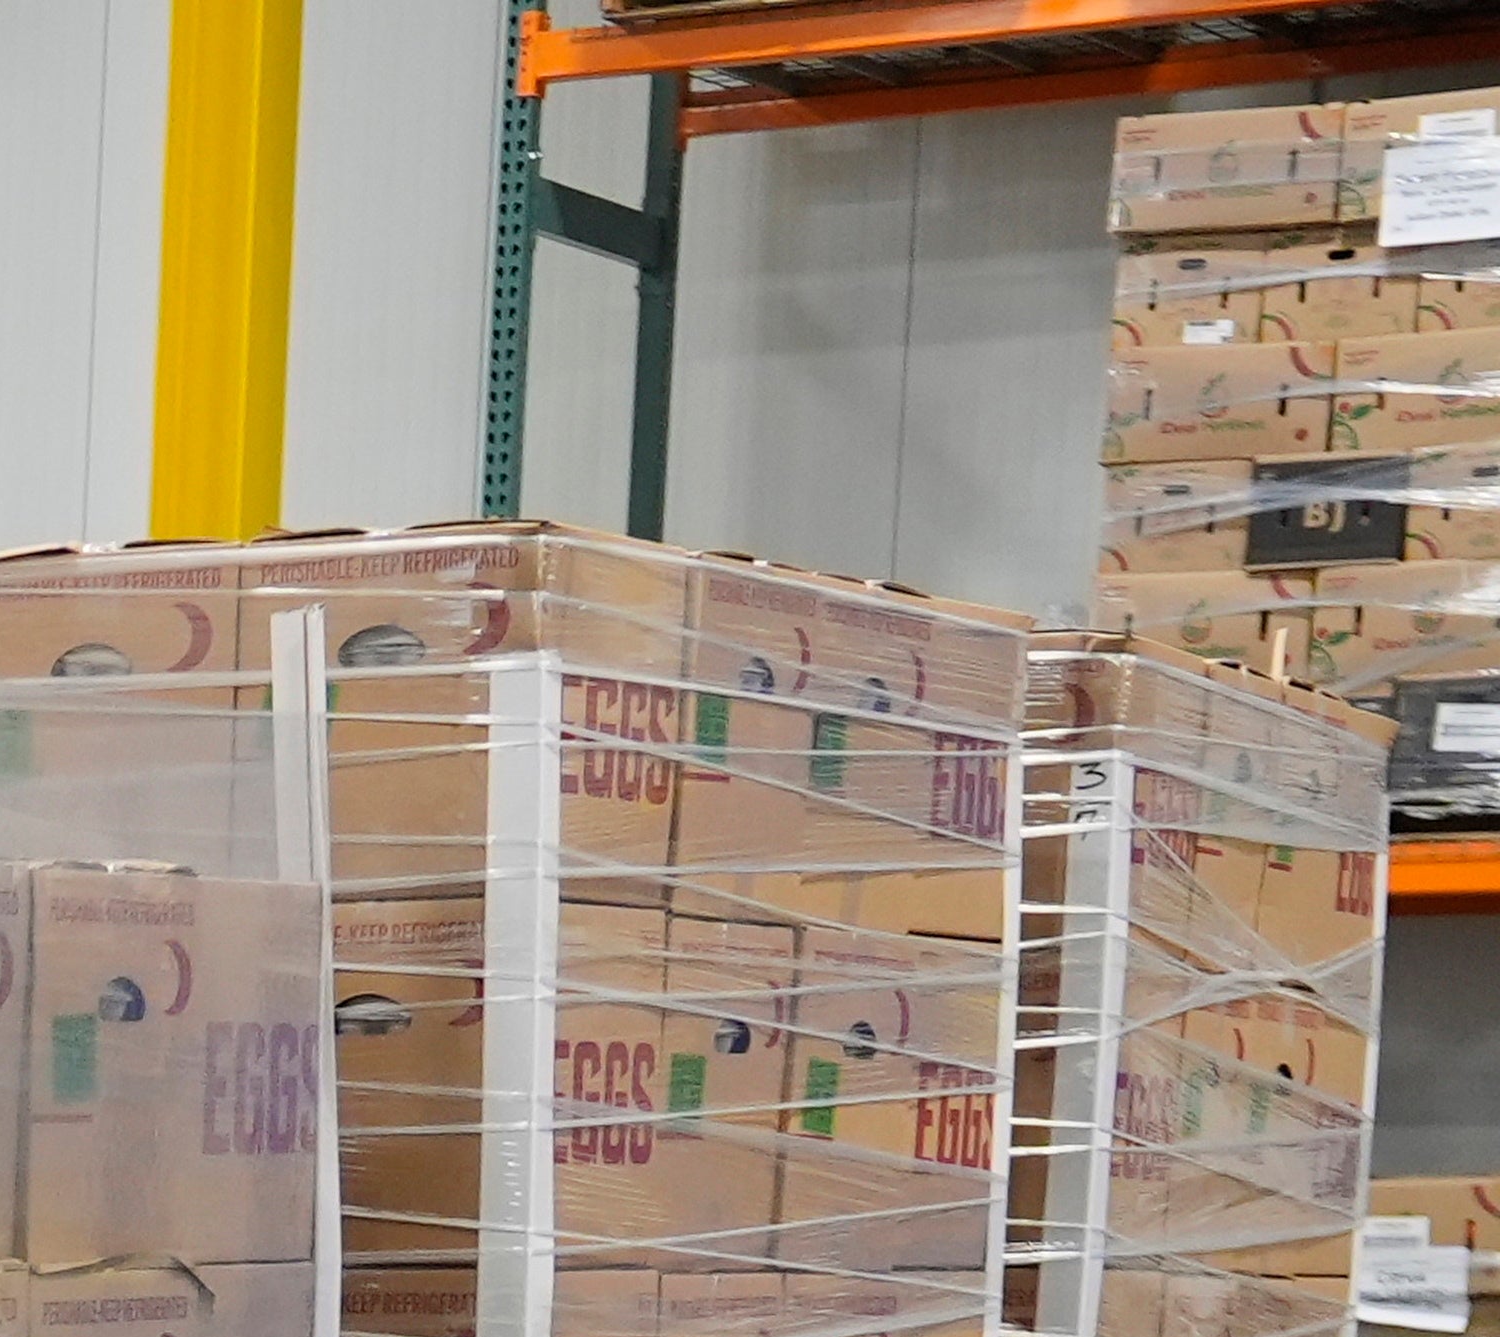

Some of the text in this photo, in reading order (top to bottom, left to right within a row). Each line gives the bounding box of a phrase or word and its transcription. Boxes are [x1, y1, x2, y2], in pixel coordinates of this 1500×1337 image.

[559, 676, 678, 804] EGGS
[930, 735, 1007, 844] EGG
[1076, 762, 1107, 790] 3
[553, 1041, 656, 1165] EGGS
